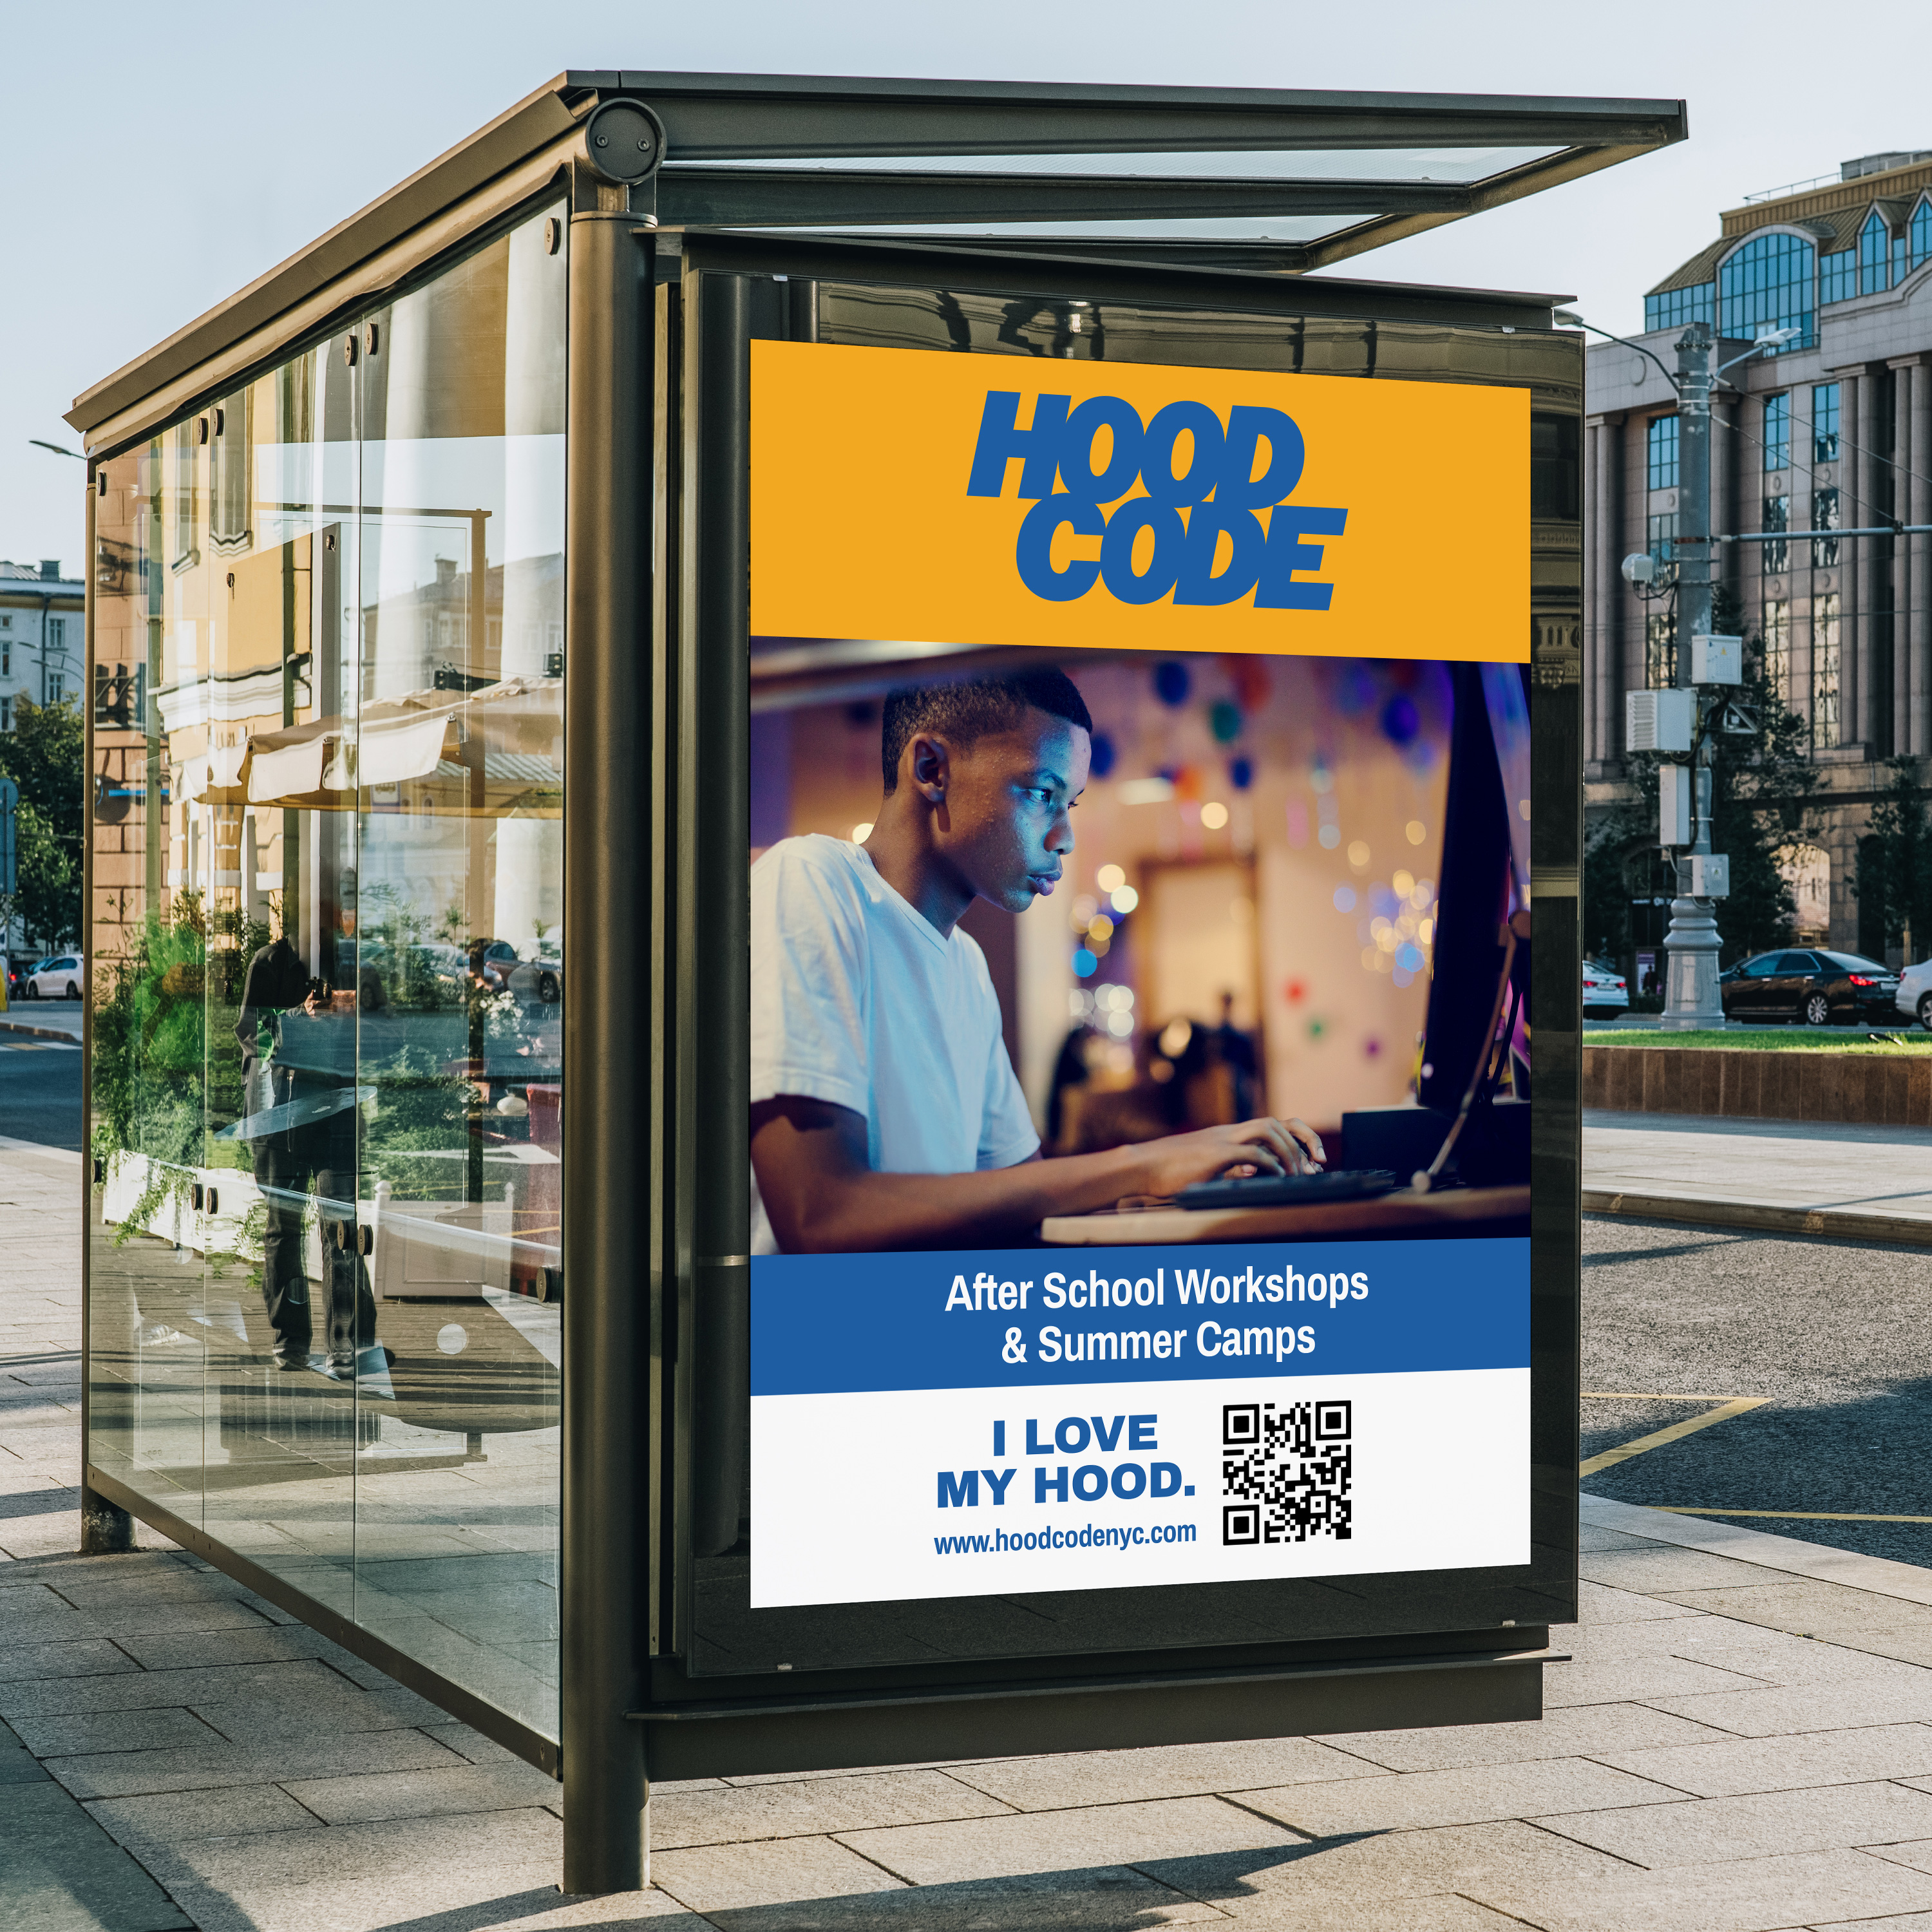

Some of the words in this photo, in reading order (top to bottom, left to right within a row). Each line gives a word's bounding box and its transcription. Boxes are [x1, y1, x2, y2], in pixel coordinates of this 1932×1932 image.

[967, 391, 1305, 510] HOOD
[1016, 493, 1348, 611] CODE
[945, 1273, 1034, 1312] After
[1043, 1269, 1164, 1309] School
[1175, 1265, 1368, 1309] Workshops
[1002, 1327, 1028, 1364] &
[1039, 1326, 1188, 1363] Summer
[1197, 1321, 1316, 1363] Camps
[994, 1421, 1005, 1457] I
[1027, 1414, 1158, 1455] LOVE
[938, 1469, 1018, 1508] MY
[1035, 1463, 1195, 1504] HOOD.
[934, 1524, 1197, 1555] www.hoodcodenyc.com
